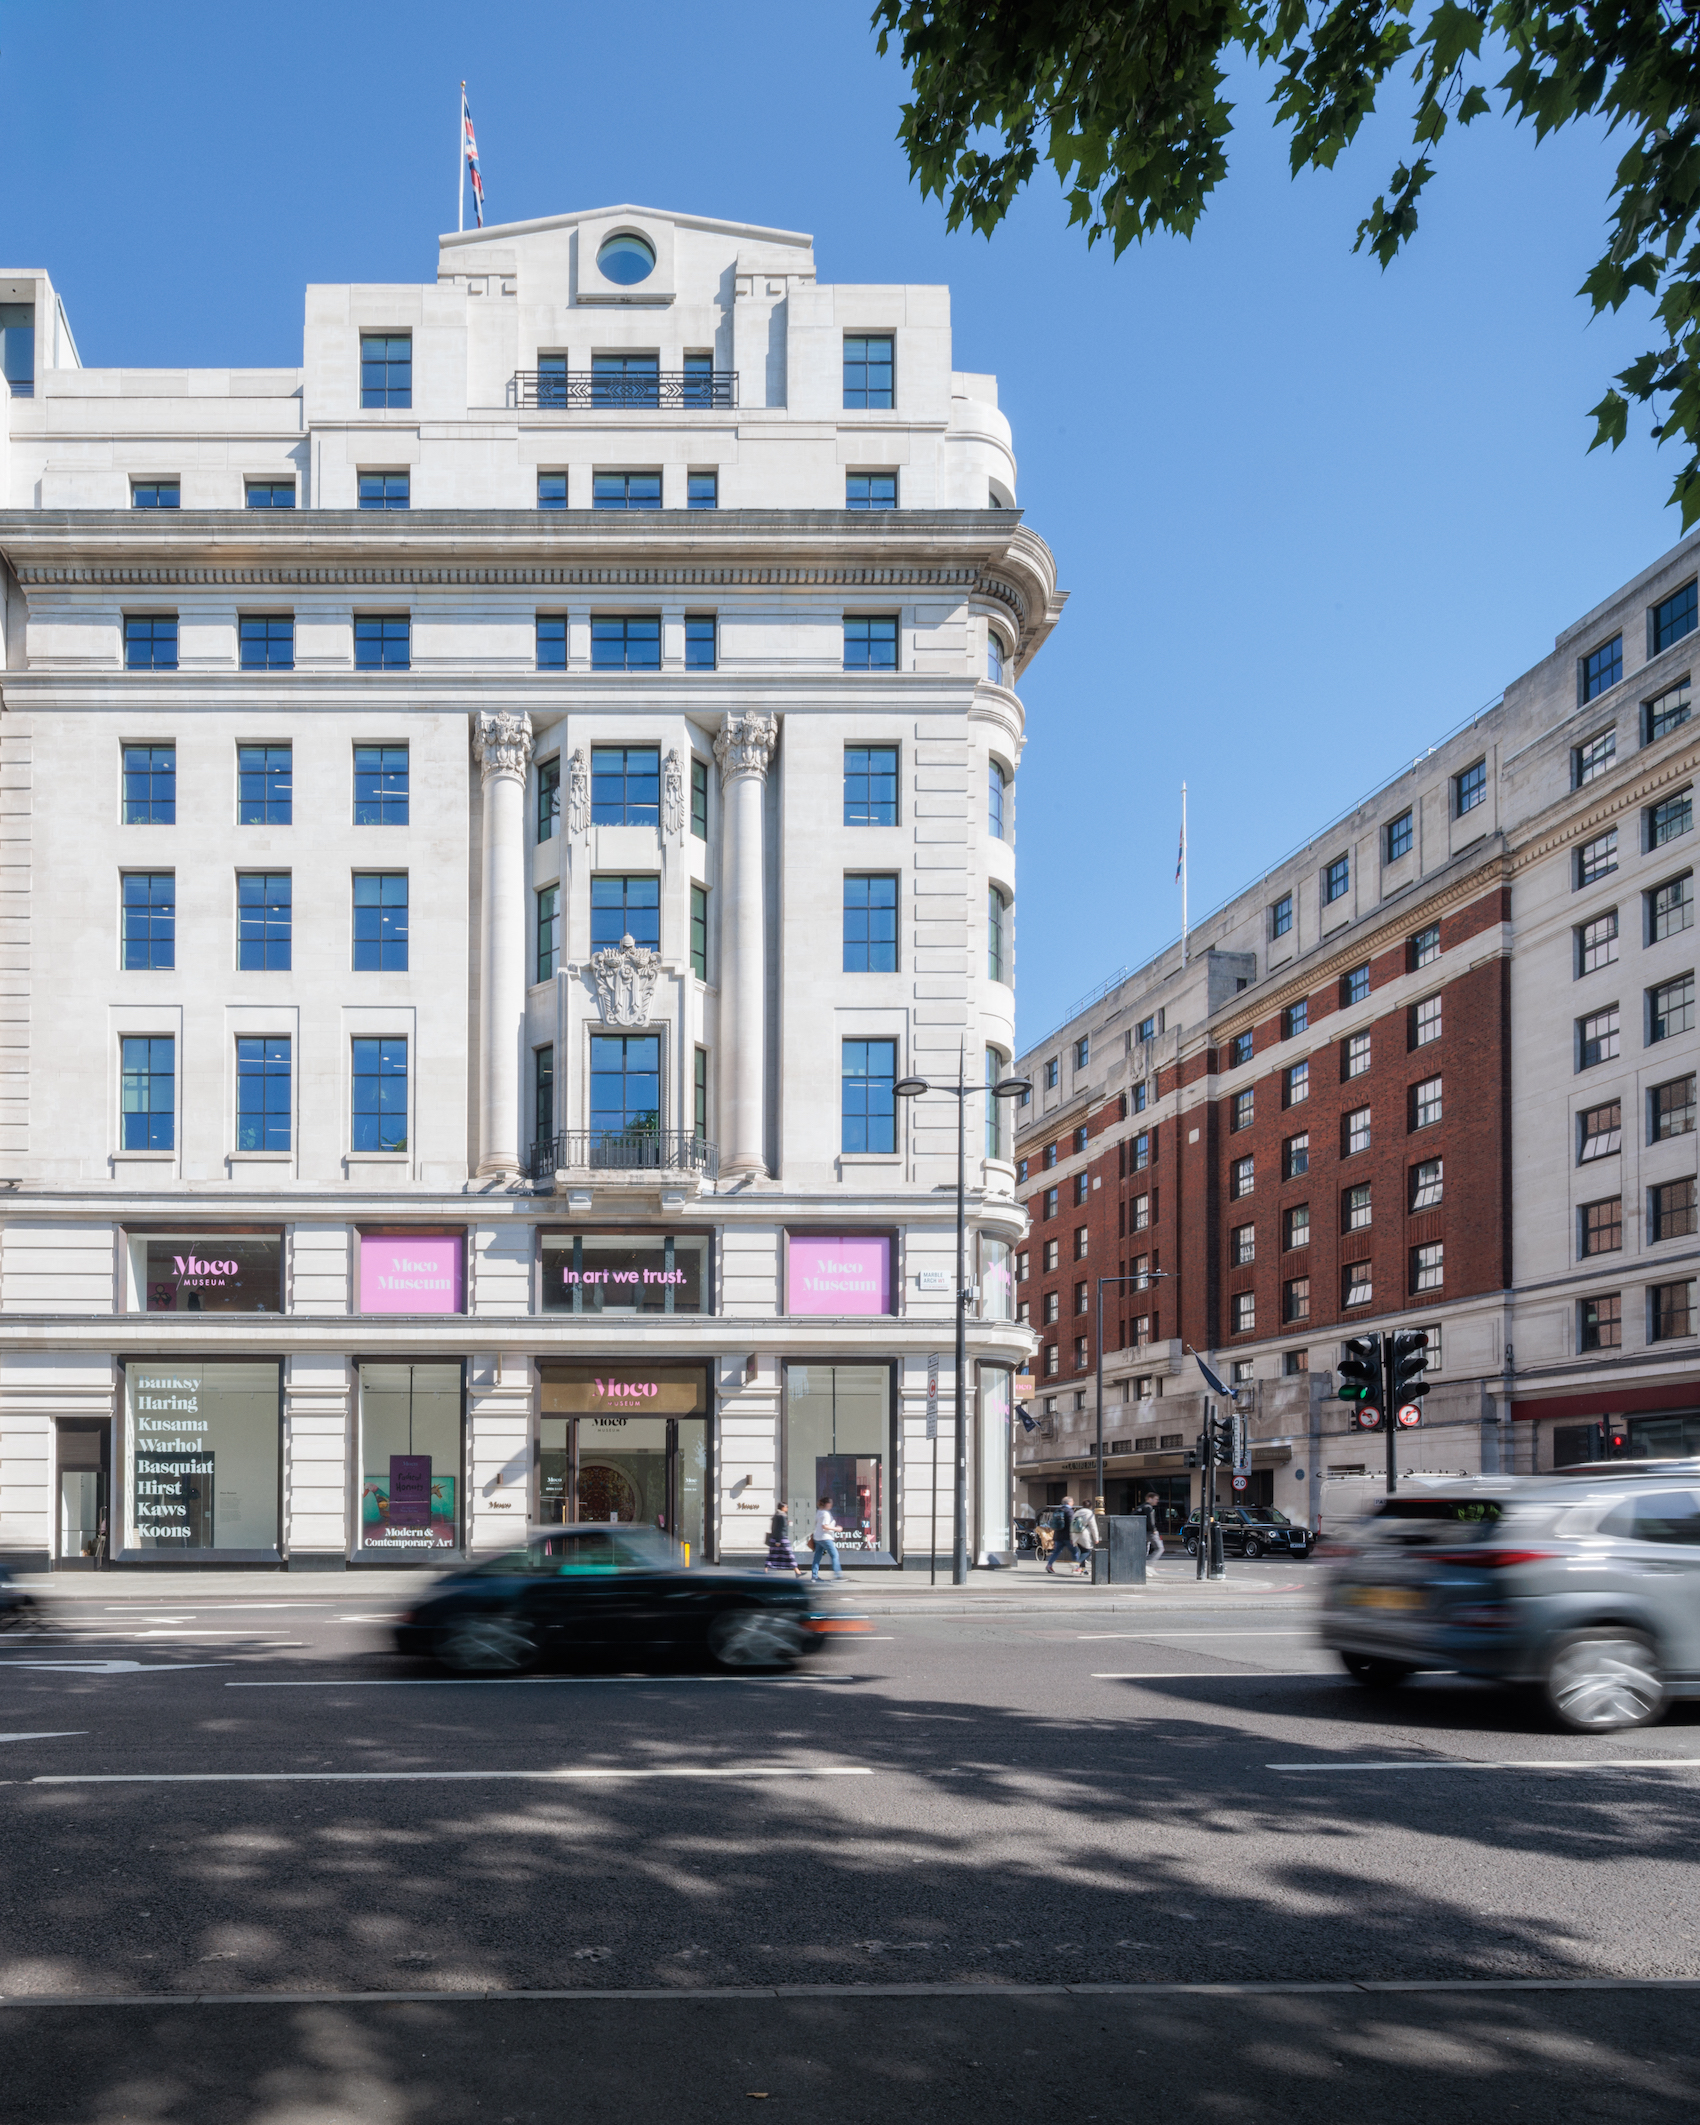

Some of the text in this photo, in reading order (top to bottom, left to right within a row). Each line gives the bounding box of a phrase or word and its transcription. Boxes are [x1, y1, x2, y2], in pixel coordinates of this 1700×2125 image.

[171, 1255, 239, 1275] Moco
[390, 1258, 438, 1273] Moco
[816, 1259, 864, 1274] Moco
[377, 1275, 452, 1290] Museum
[563, 1266, 687, 1285] In art we trust.
[802, 1277, 877, 1291] Museum
[138, 1375, 202, 1392] Banksy
[591, 1378, 658, 1397] Moco
[138, 1395, 199, 1413] Haring
[138, 1417, 208, 1431] Kusama
[592, 1418, 627, 1427] Moco
[138, 1438, 203, 1453] Warhol
[137, 1459, 214, 1477] Basquiat
[137, 1479, 182, 1495] Hirst
[1234, 1479, 1246, 1487] 20
[137, 1502, 187, 1516] Kaws
[137, 1523, 191, 1538] Koons
[385, 1527, 434, 1537] Modern &
[852, 1529, 862, 1539] &
[364, 1538, 453, 1549] Contemporary Art
[864, 1540, 881, 1549] Art
